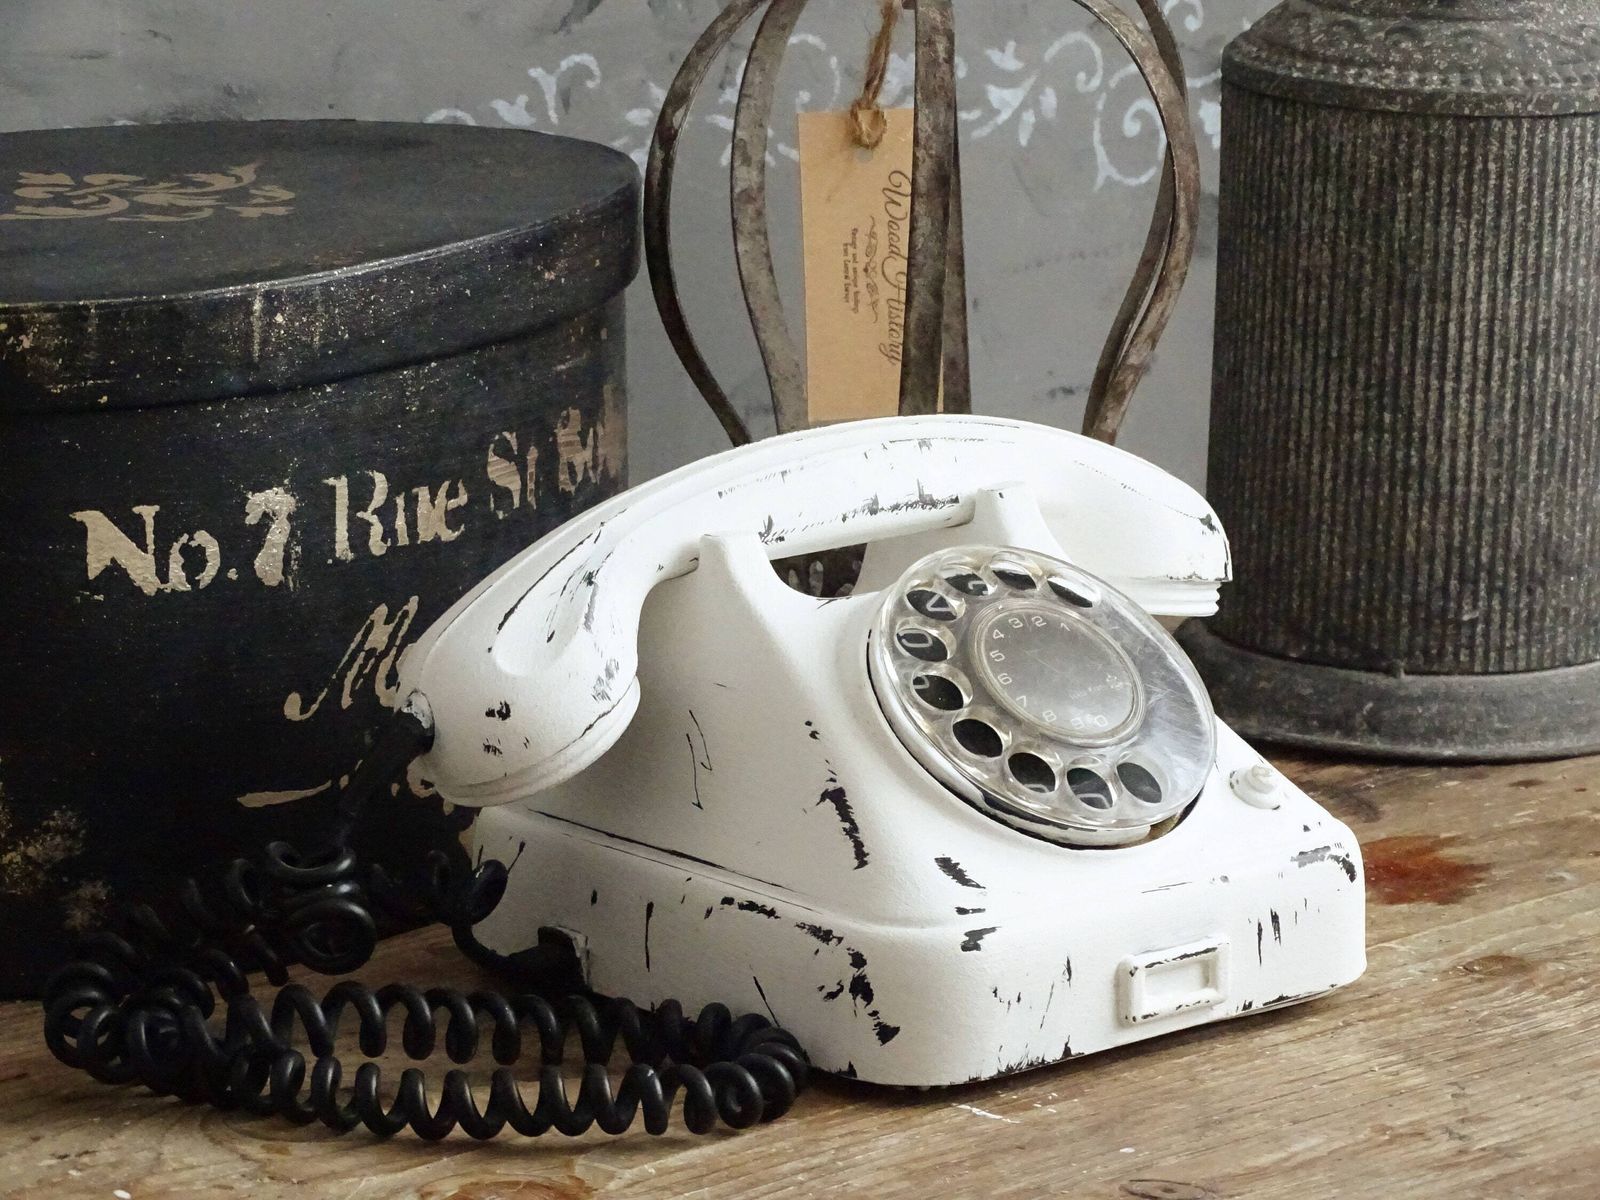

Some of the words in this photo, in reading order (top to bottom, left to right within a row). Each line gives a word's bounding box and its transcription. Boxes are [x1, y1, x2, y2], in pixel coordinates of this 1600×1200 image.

[882, 170, 912, 260] Wood
[69, 503, 238, 596] No.
[244, 486, 299, 586] 7
[320, 468, 468, 562] Rue
[992, 628, 1005, 640] 4
[989, 649, 1006, 662] 5
[997, 672, 1013, 685] 6
